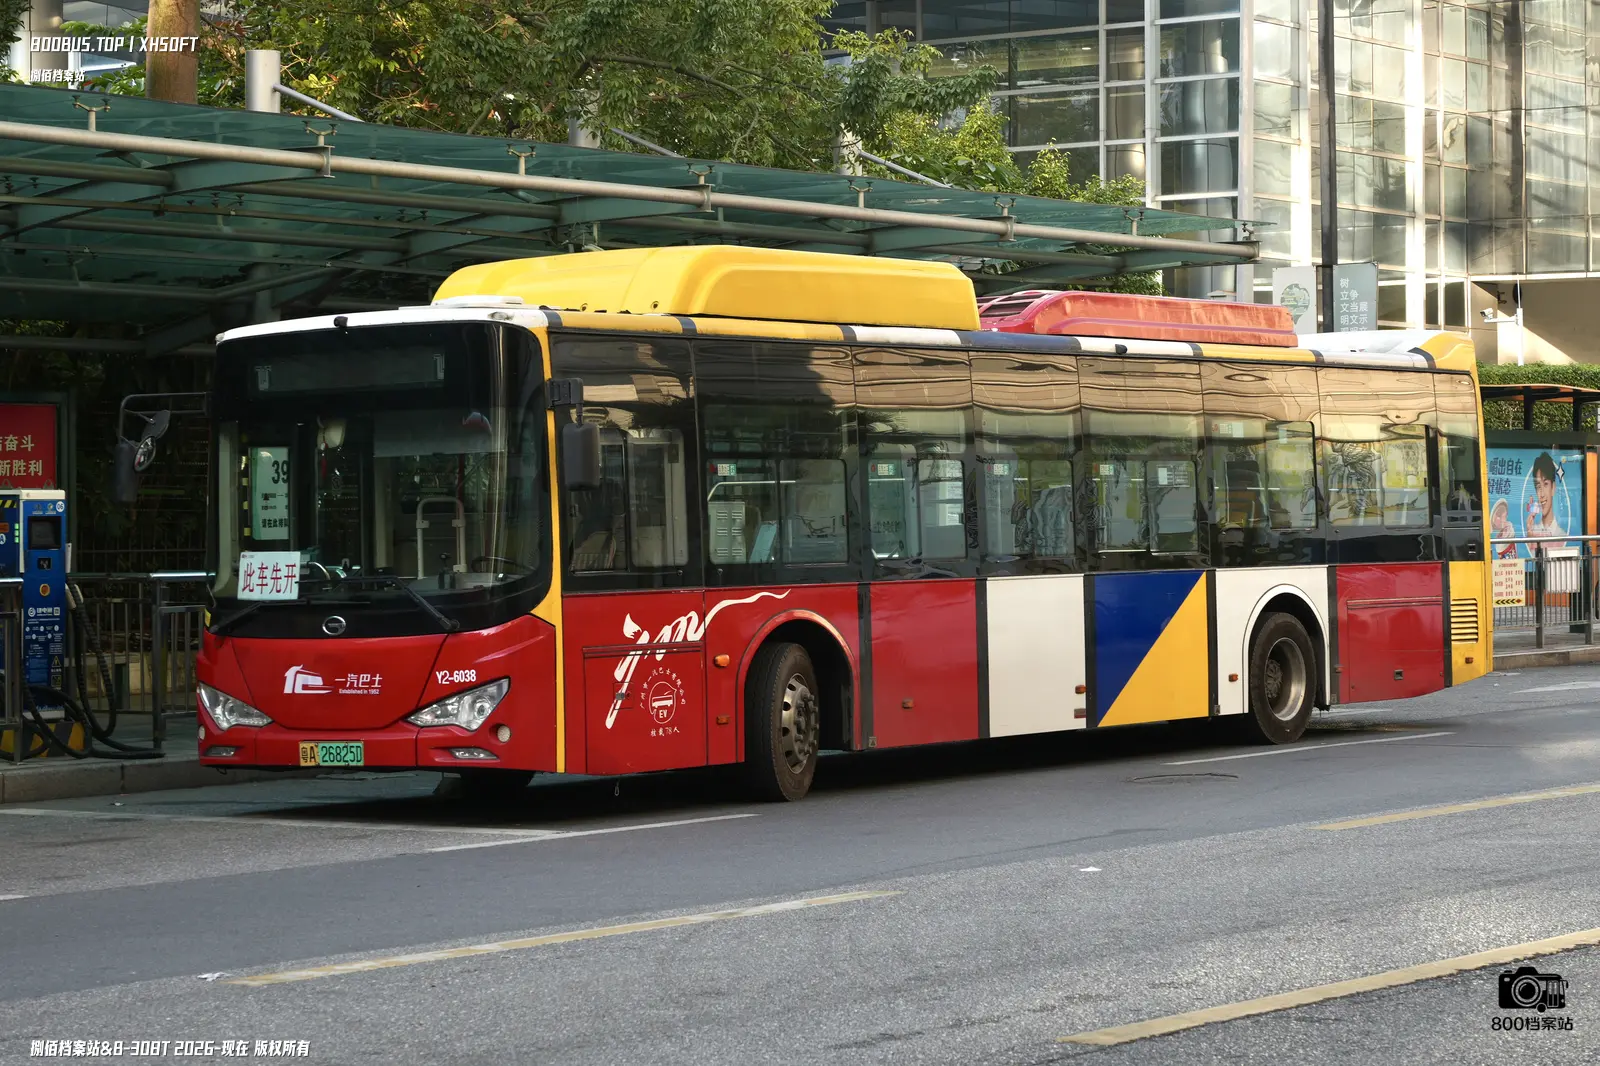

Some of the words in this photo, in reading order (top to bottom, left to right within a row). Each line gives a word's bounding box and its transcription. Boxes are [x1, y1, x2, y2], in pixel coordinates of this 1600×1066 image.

[0, 434, 35, 452] 奋斗
[241, 561, 297, 595] 此车先开
[334, 673, 383, 688] 一汽巴士
[435, 669, 477, 685] Y2-6038
[659, 709, 668, 719] EV
